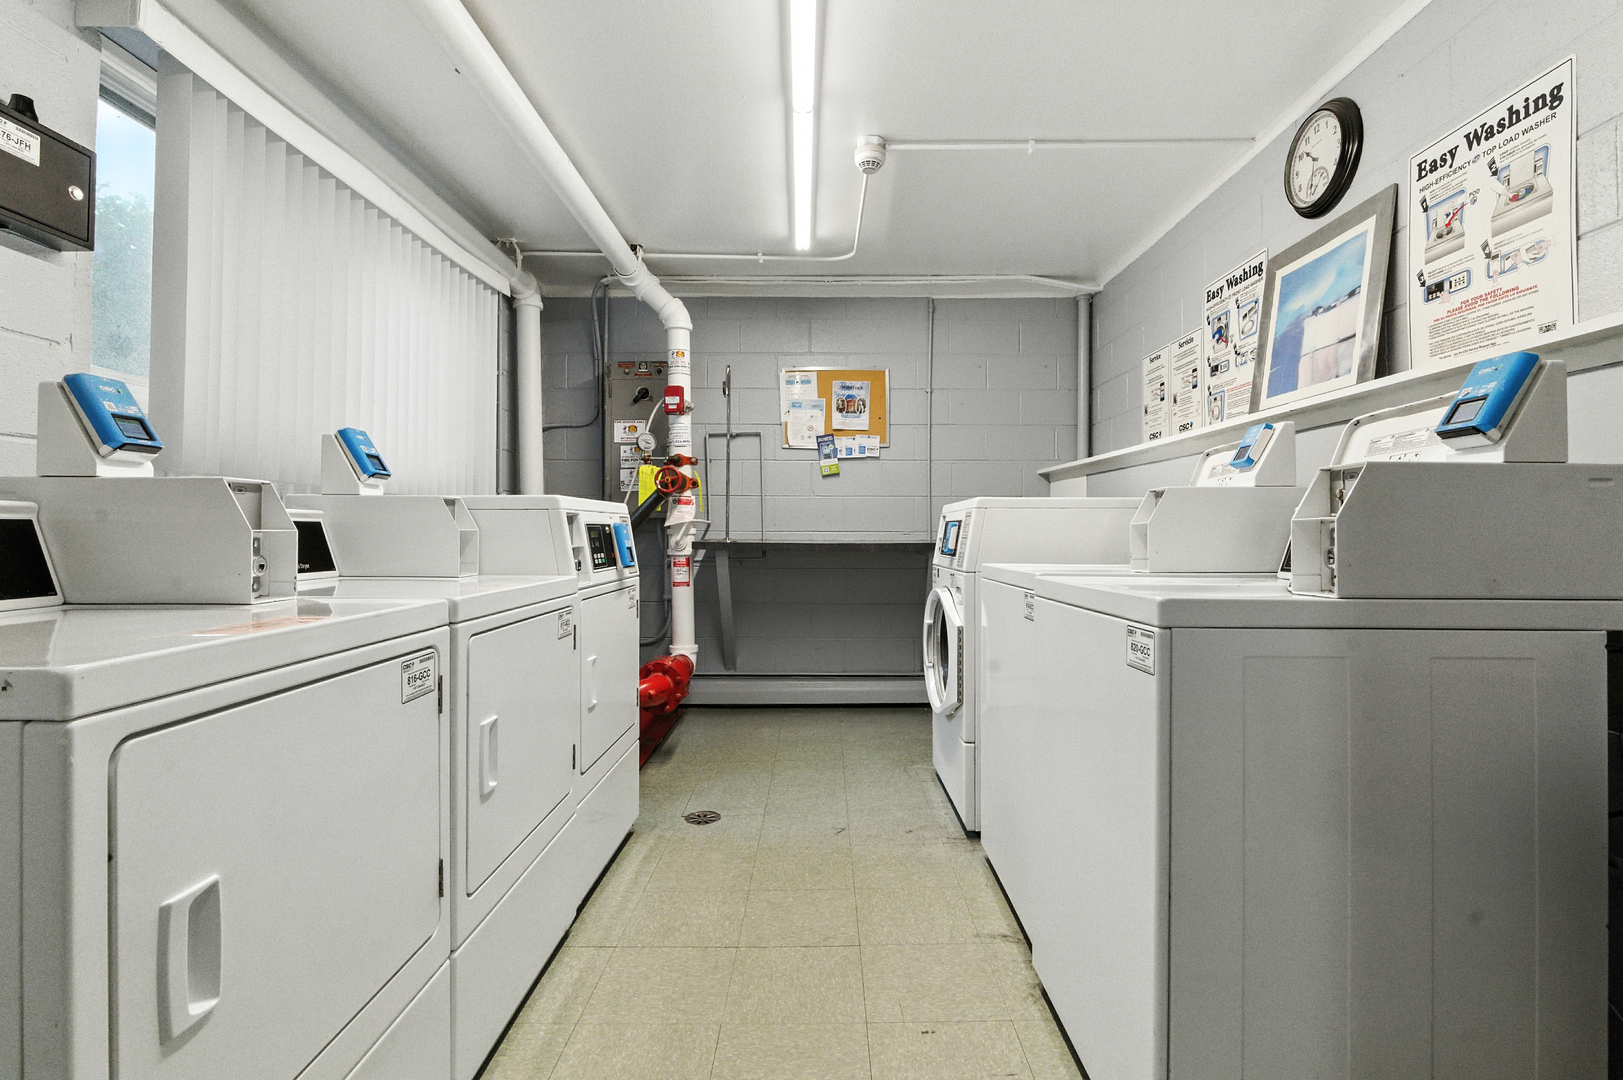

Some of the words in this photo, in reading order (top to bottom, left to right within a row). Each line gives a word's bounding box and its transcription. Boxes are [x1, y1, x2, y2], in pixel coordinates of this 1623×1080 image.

[1416, 144, 1460, 182] Easy
[1463, 82, 1564, 151] Washing
[0, 130, 31, 151] 76-JFH
[1419, 159, 1472, 194] HIGH-EFFICIENCY
[1482, 146, 1497, 158] TOP
[1498, 132, 1520, 149] LOAD
[1521, 111, 1557, 136] WASHER
[1469, 188, 1480, 197] POD
[1206, 285, 1224, 303] Easy
[1226, 261, 1264, 291] Washing
[1484, 287, 1502, 296] SAFETY
[1489, 286, 1519, 299] FOLLOWING
[1179, 423, 1190, 432] CSC
[1149, 432, 1159, 440] CSC
[407, 669, 431, 686] 816-GCC
